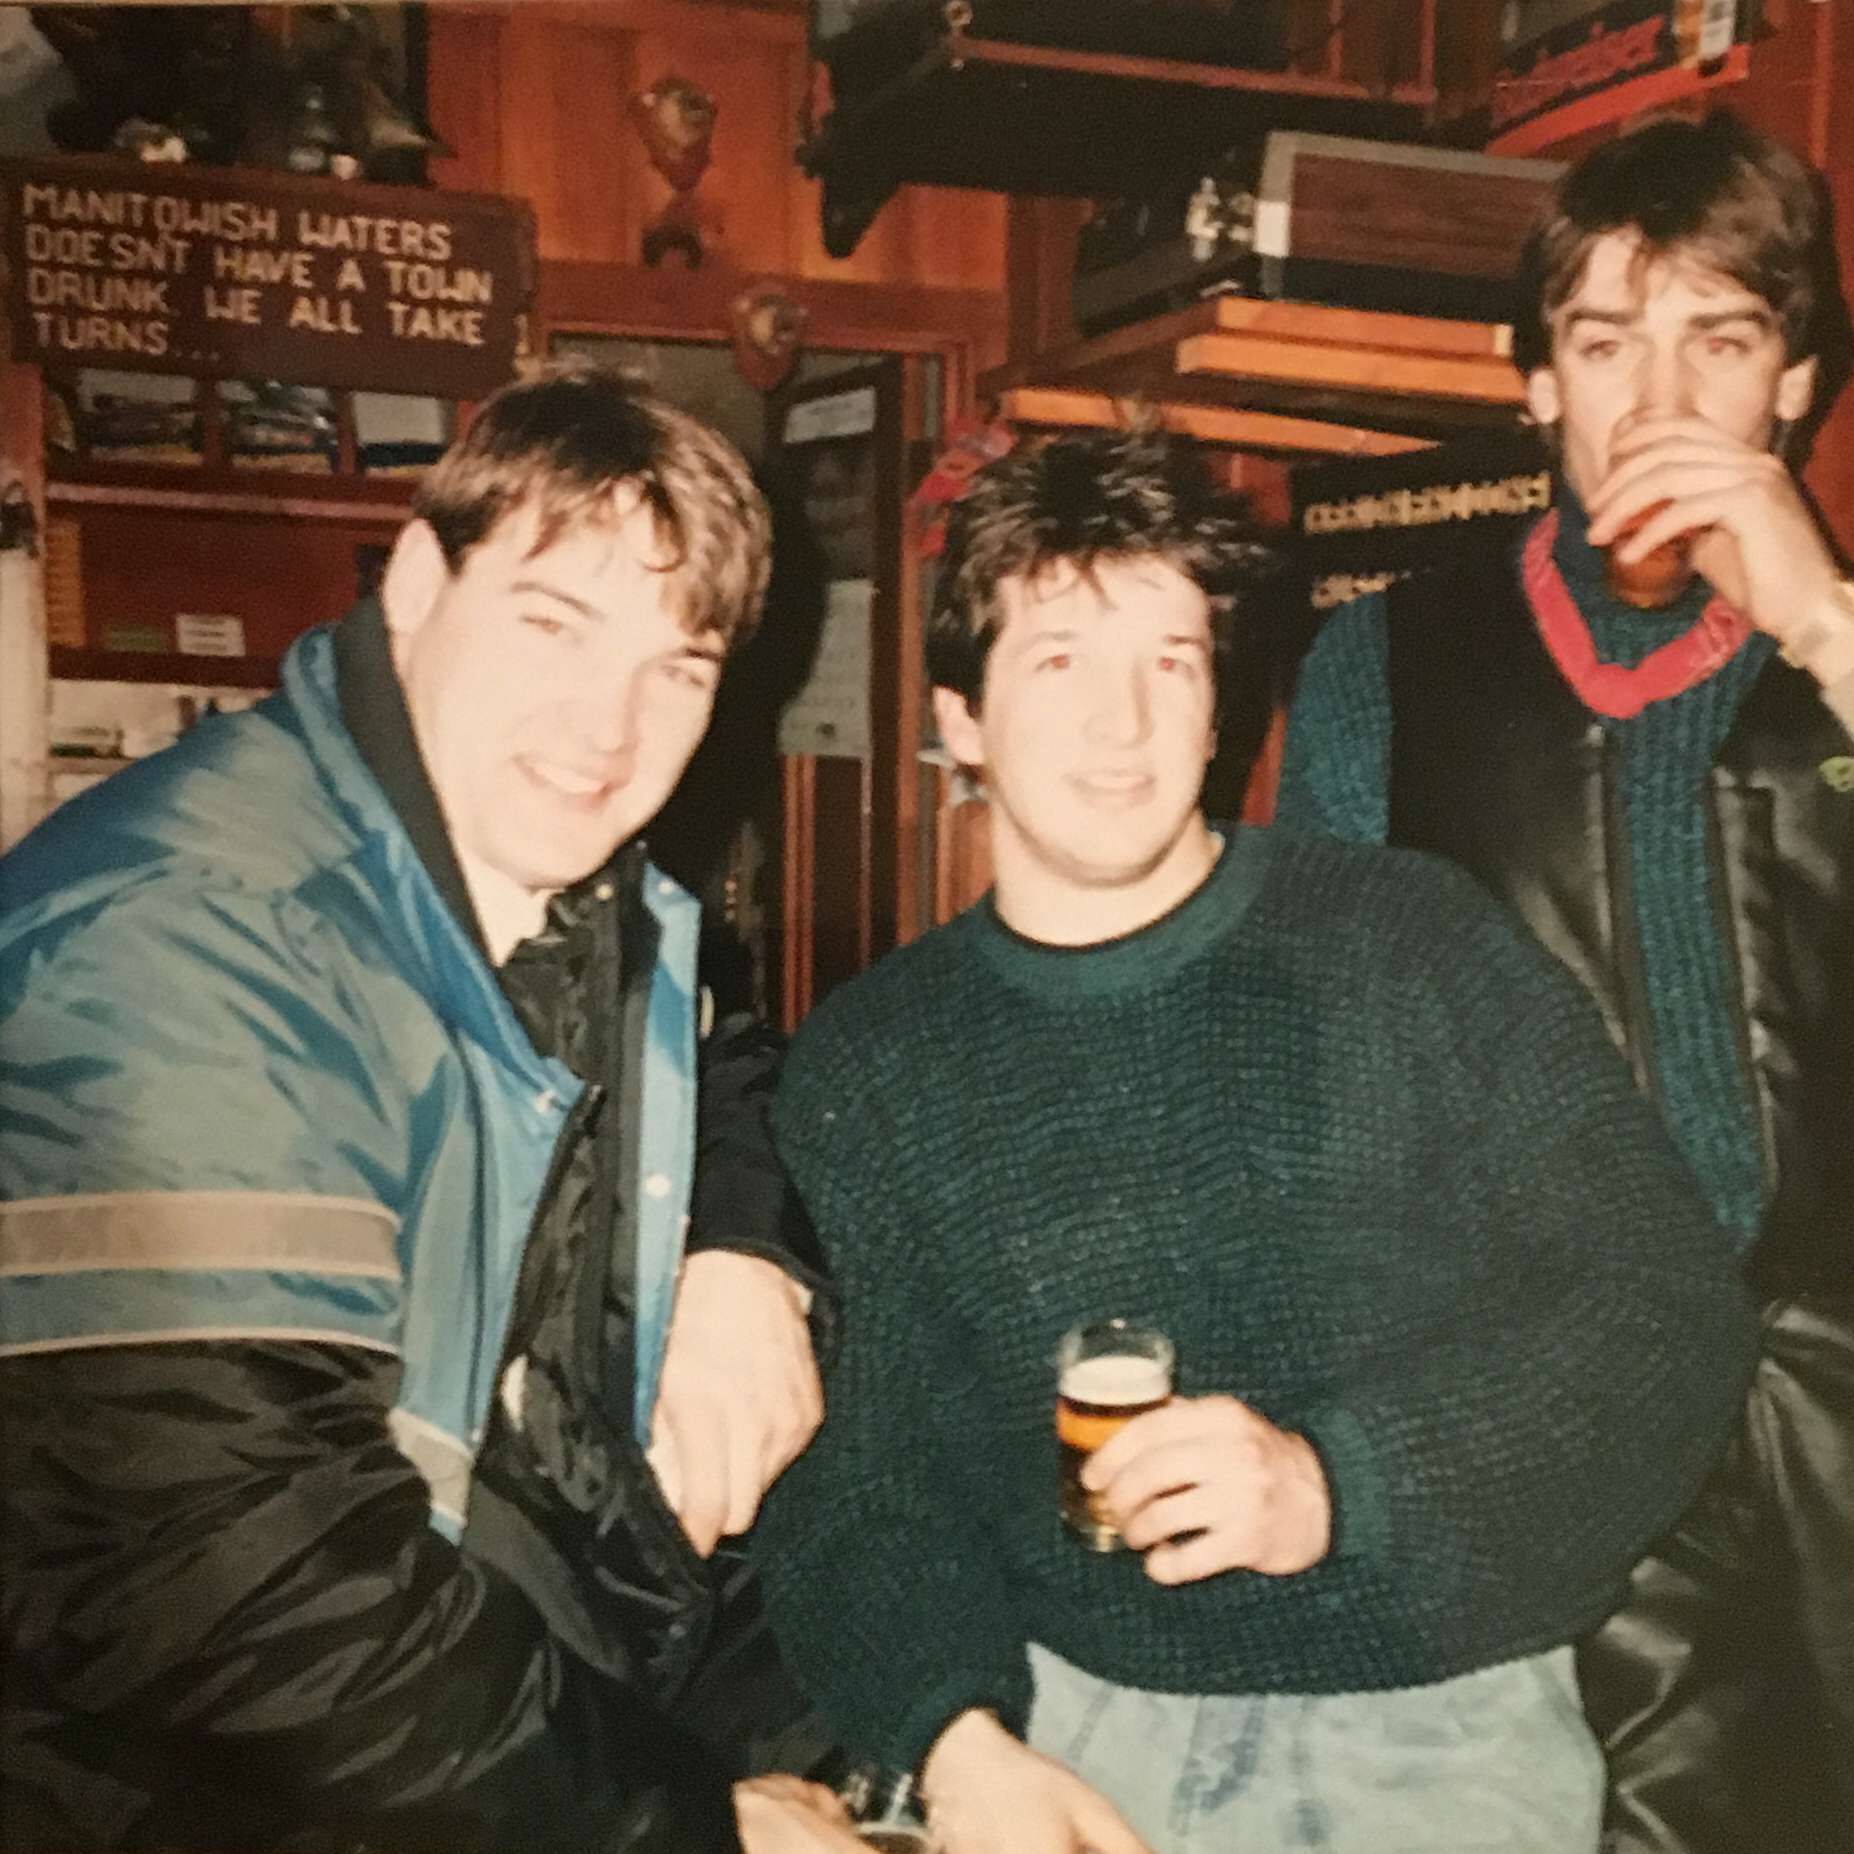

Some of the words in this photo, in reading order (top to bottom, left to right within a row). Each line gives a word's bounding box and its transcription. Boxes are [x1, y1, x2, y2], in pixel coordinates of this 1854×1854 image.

[23, 184, 278, 242] MANITOWISH
[300, 211, 453, 261] WATERS
[214, 247, 316, 289] HAVE
[336, 258, 366, 291] A
[385, 260, 494, 305] TOWN
[204, 285, 263, 325] WE
[289, 296, 364, 335] ALL
[386, 300, 486, 347] TAKE
